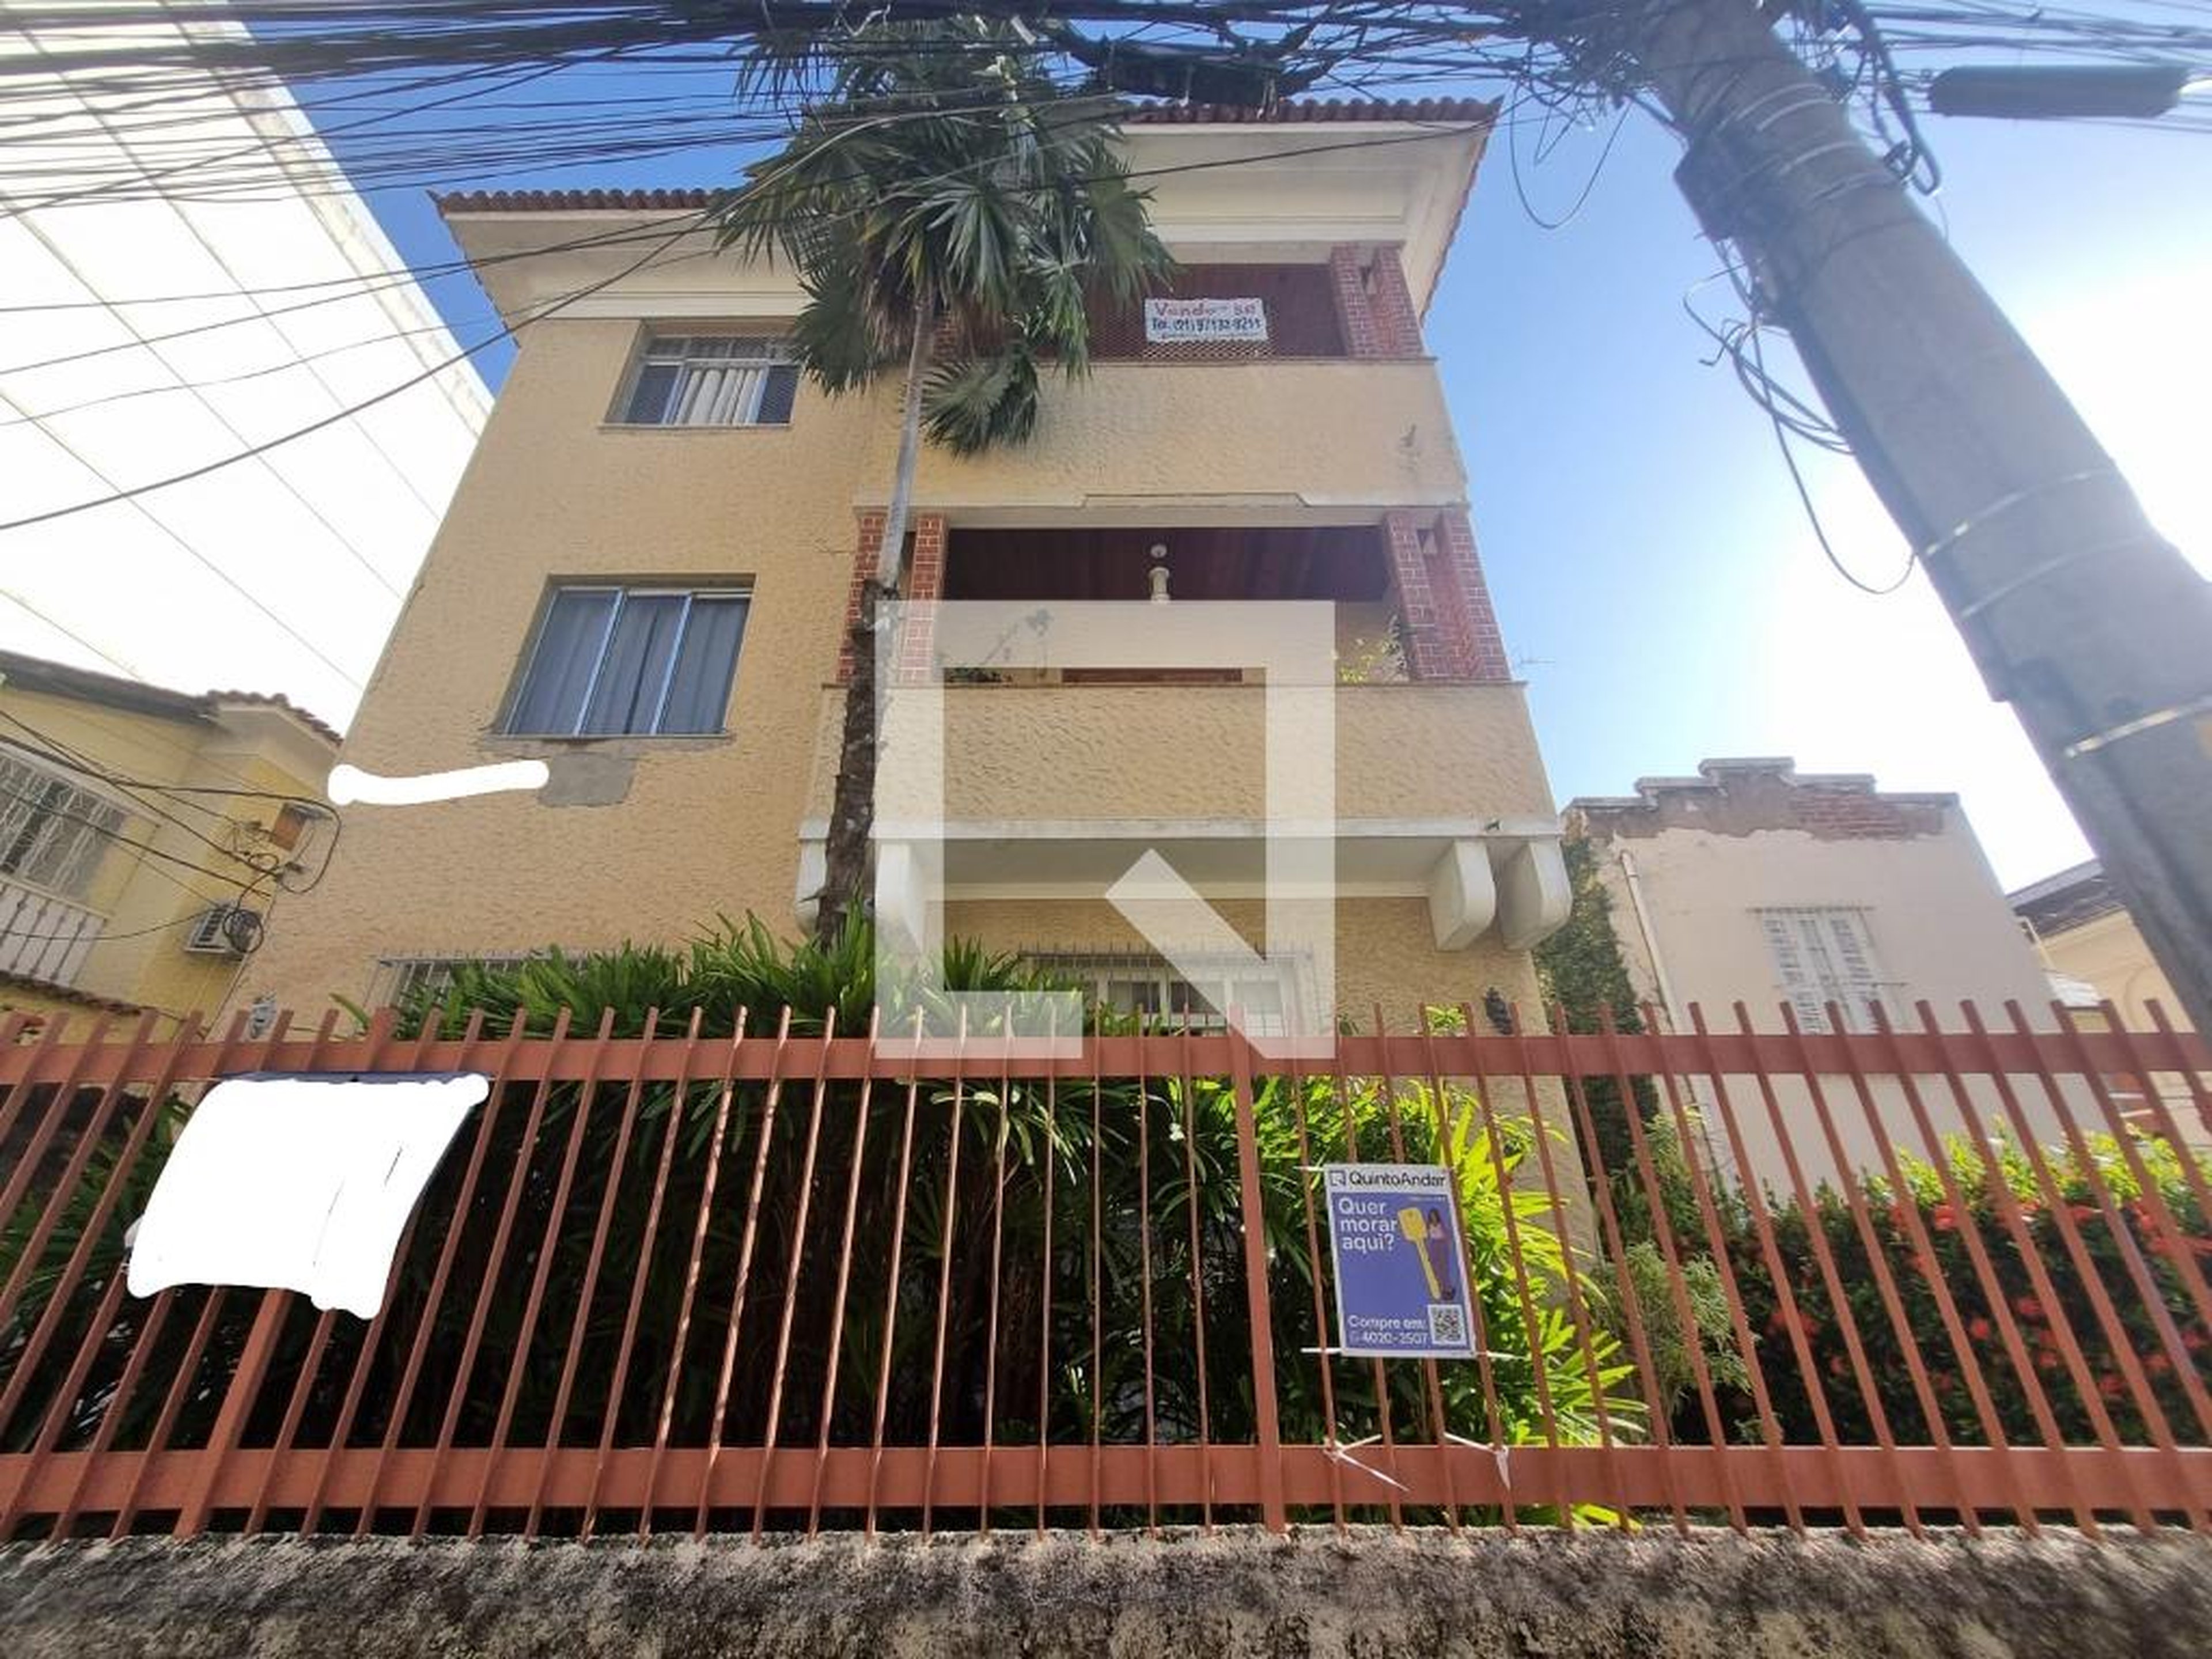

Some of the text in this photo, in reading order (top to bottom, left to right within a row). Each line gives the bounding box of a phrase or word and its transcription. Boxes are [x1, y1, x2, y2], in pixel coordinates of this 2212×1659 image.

[1349, 1171, 1446, 1187] QuintoAndar
[1338, 1198, 1387, 1215] Quer
[1340, 1218, 1397, 1232] morar
[1342, 1233, 1395, 1254] aqui?
[1348, 1315, 1401, 1331] Compre
